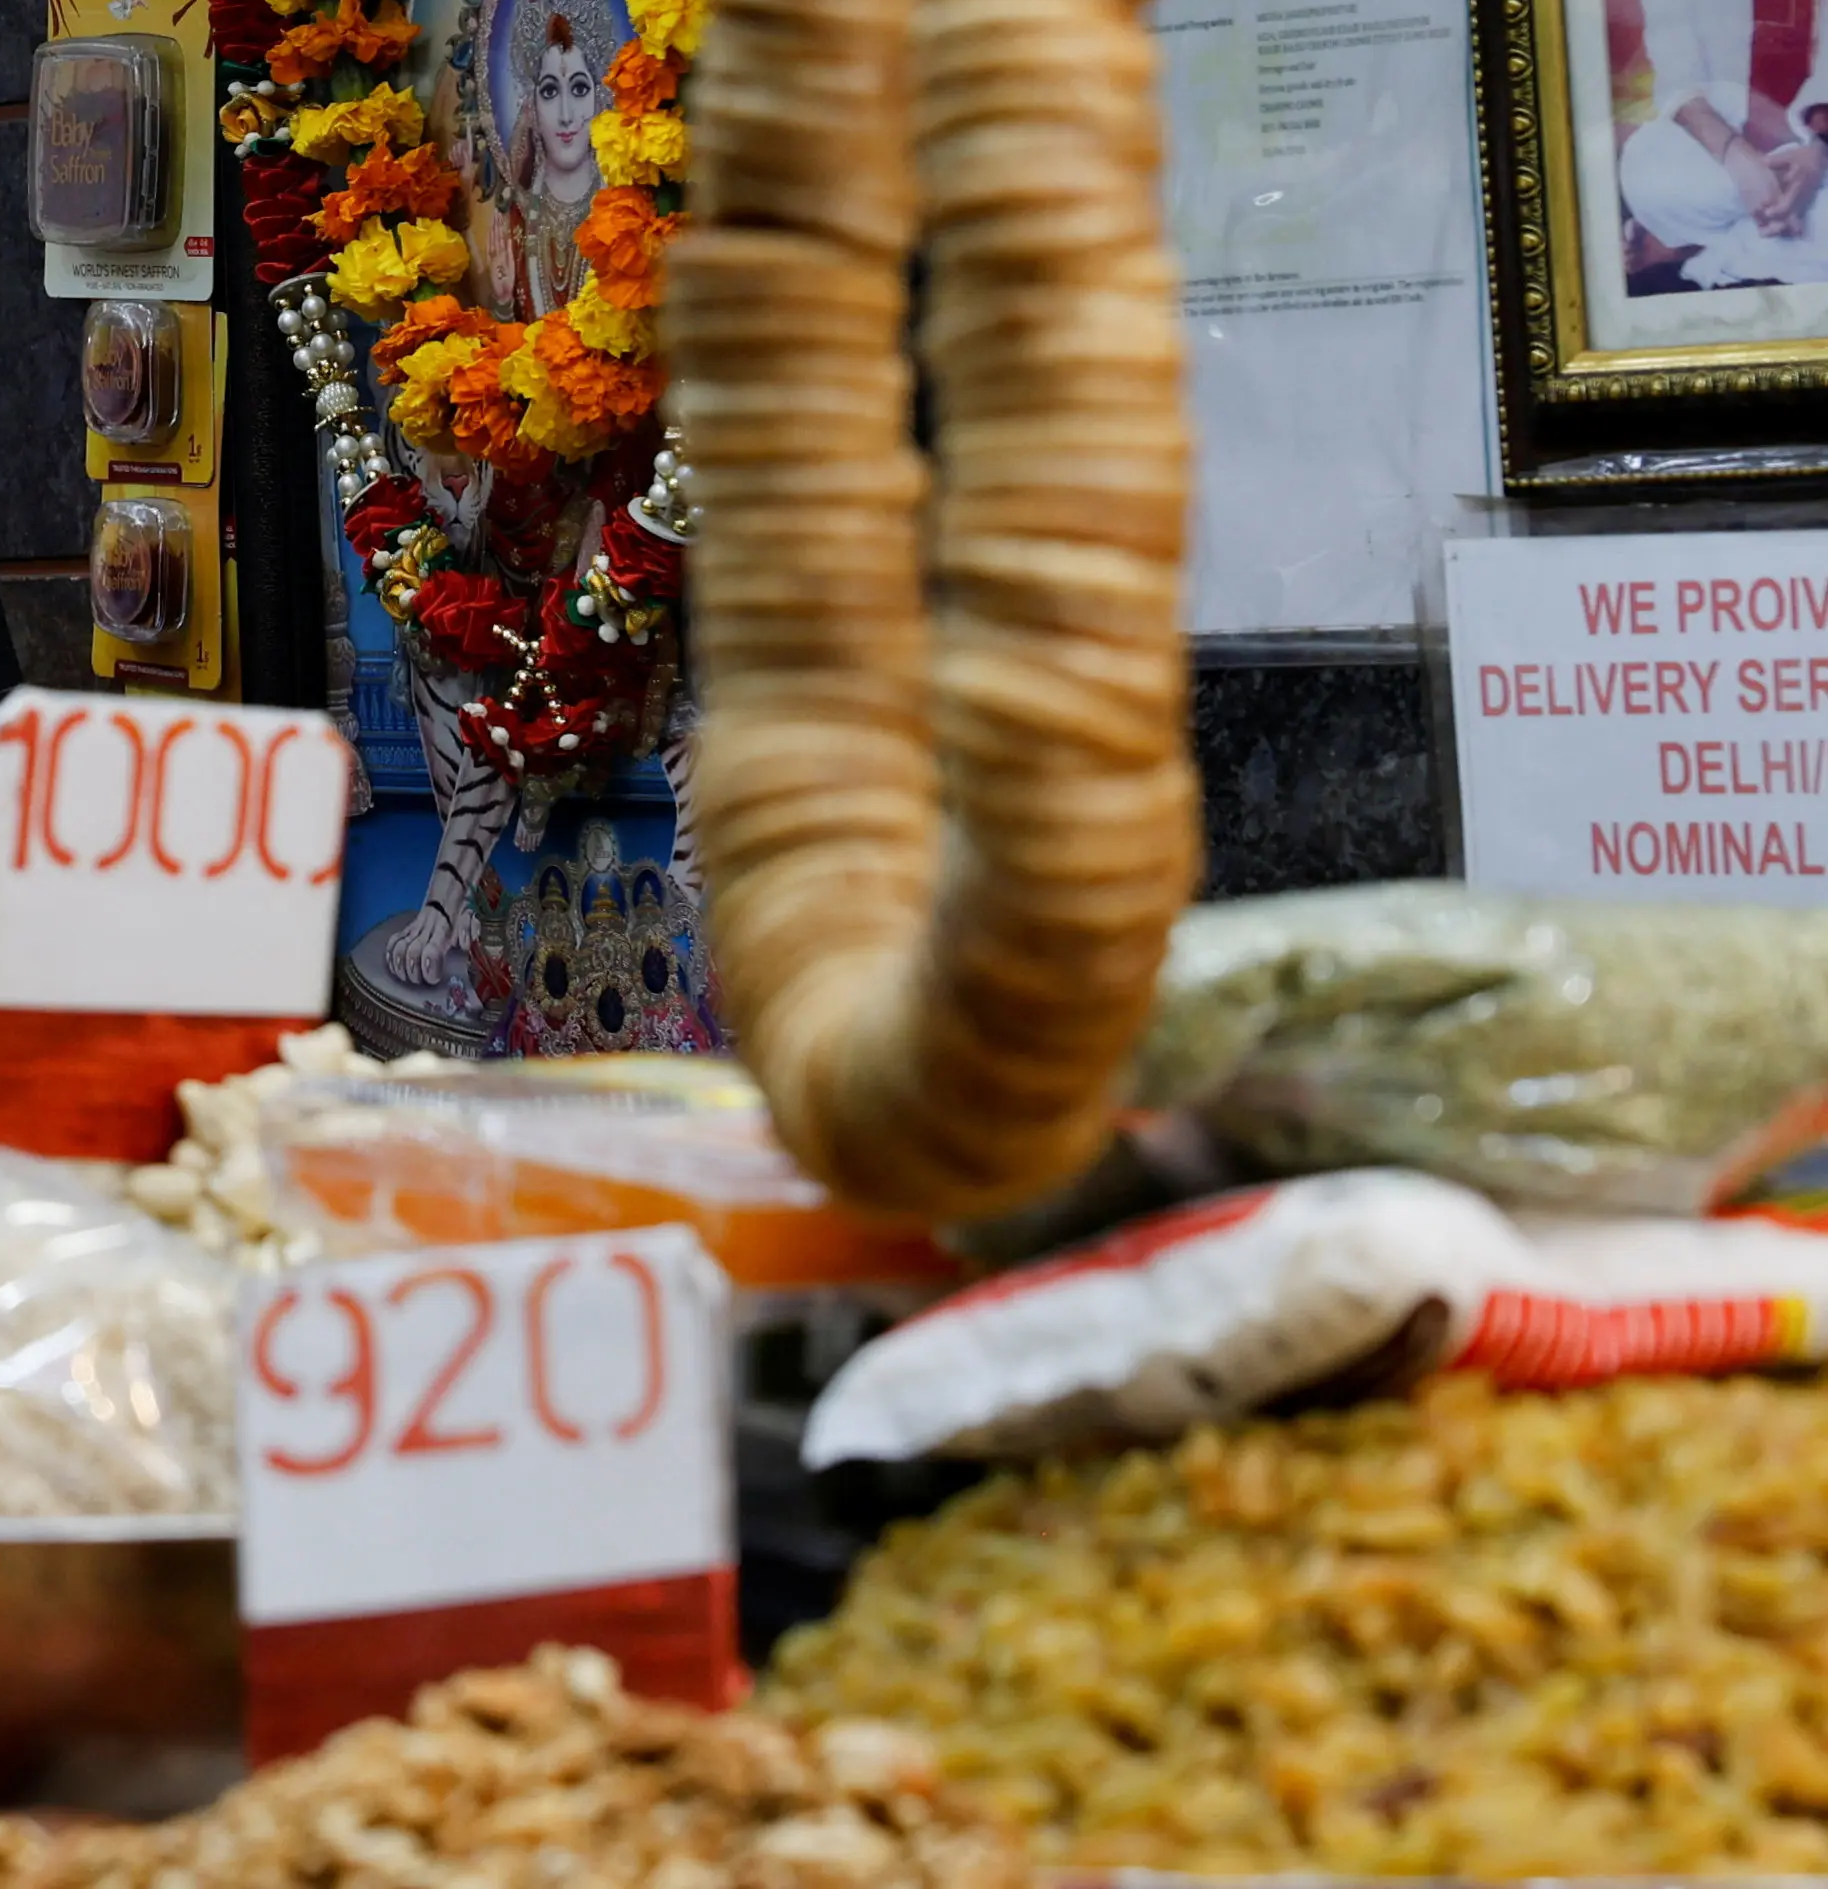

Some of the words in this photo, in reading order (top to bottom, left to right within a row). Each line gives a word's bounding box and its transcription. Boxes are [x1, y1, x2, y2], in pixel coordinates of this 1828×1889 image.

[50, 110, 95, 158] Baby
[49, 154, 105, 185] Saffron
[72, 263, 110, 278] WORLD'S
[111, 264, 140, 279] FINEST
[141, 264, 180, 280] SAFFRON
[1578, 581, 1659, 636] WE
[1479, 659, 1720, 718] DELIVERY
[1658, 739, 1826, 796] DELHI/
[1590, 820, 1826, 876] NOMINAL
[252, 1251, 667, 1477] 920
